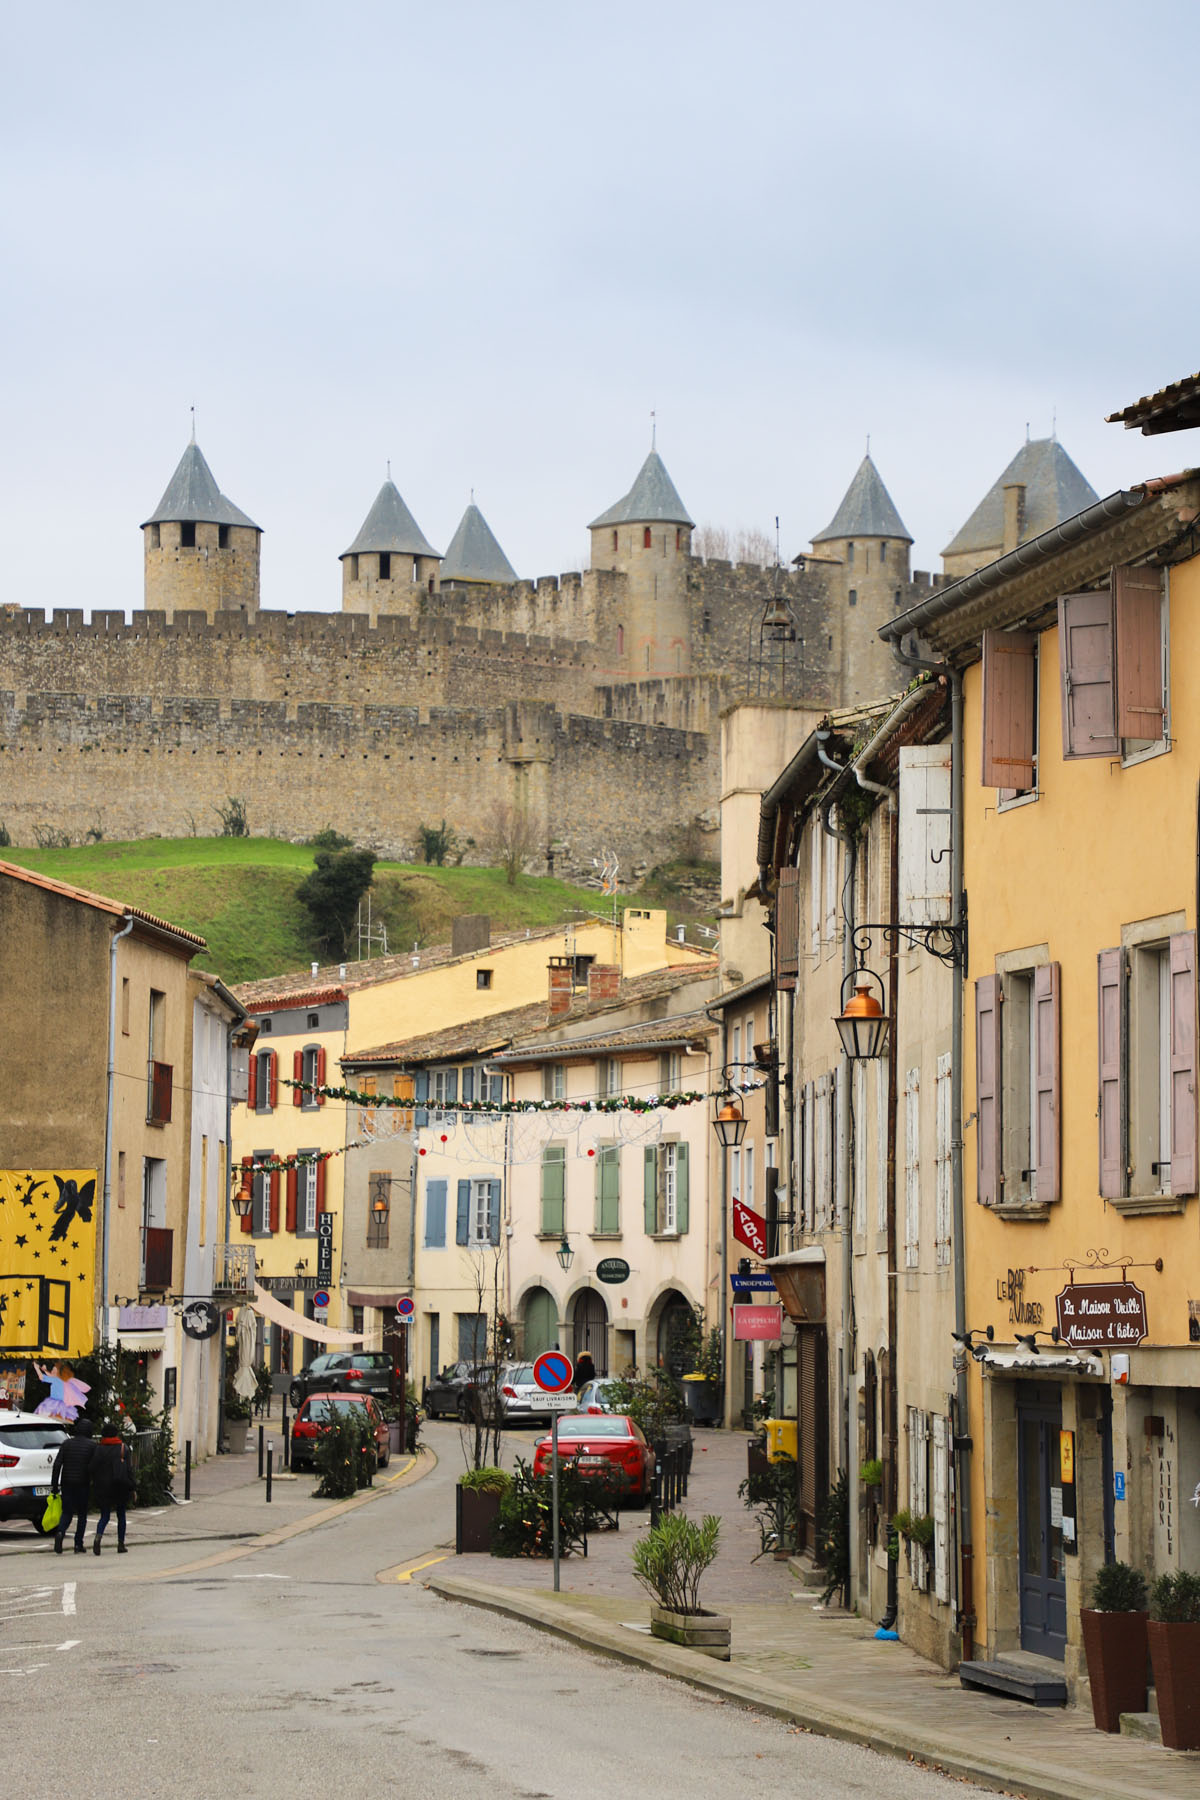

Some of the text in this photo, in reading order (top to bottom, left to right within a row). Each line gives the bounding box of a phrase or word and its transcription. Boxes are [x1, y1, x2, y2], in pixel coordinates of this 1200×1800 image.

[734, 1203, 765, 1254] TABAC
[1008, 1268, 1024, 1300] BAR
[1064, 1298, 1141, 1315] La Maison Vieille
[1067, 1323, 1140, 1340] Maison d'hôtes
